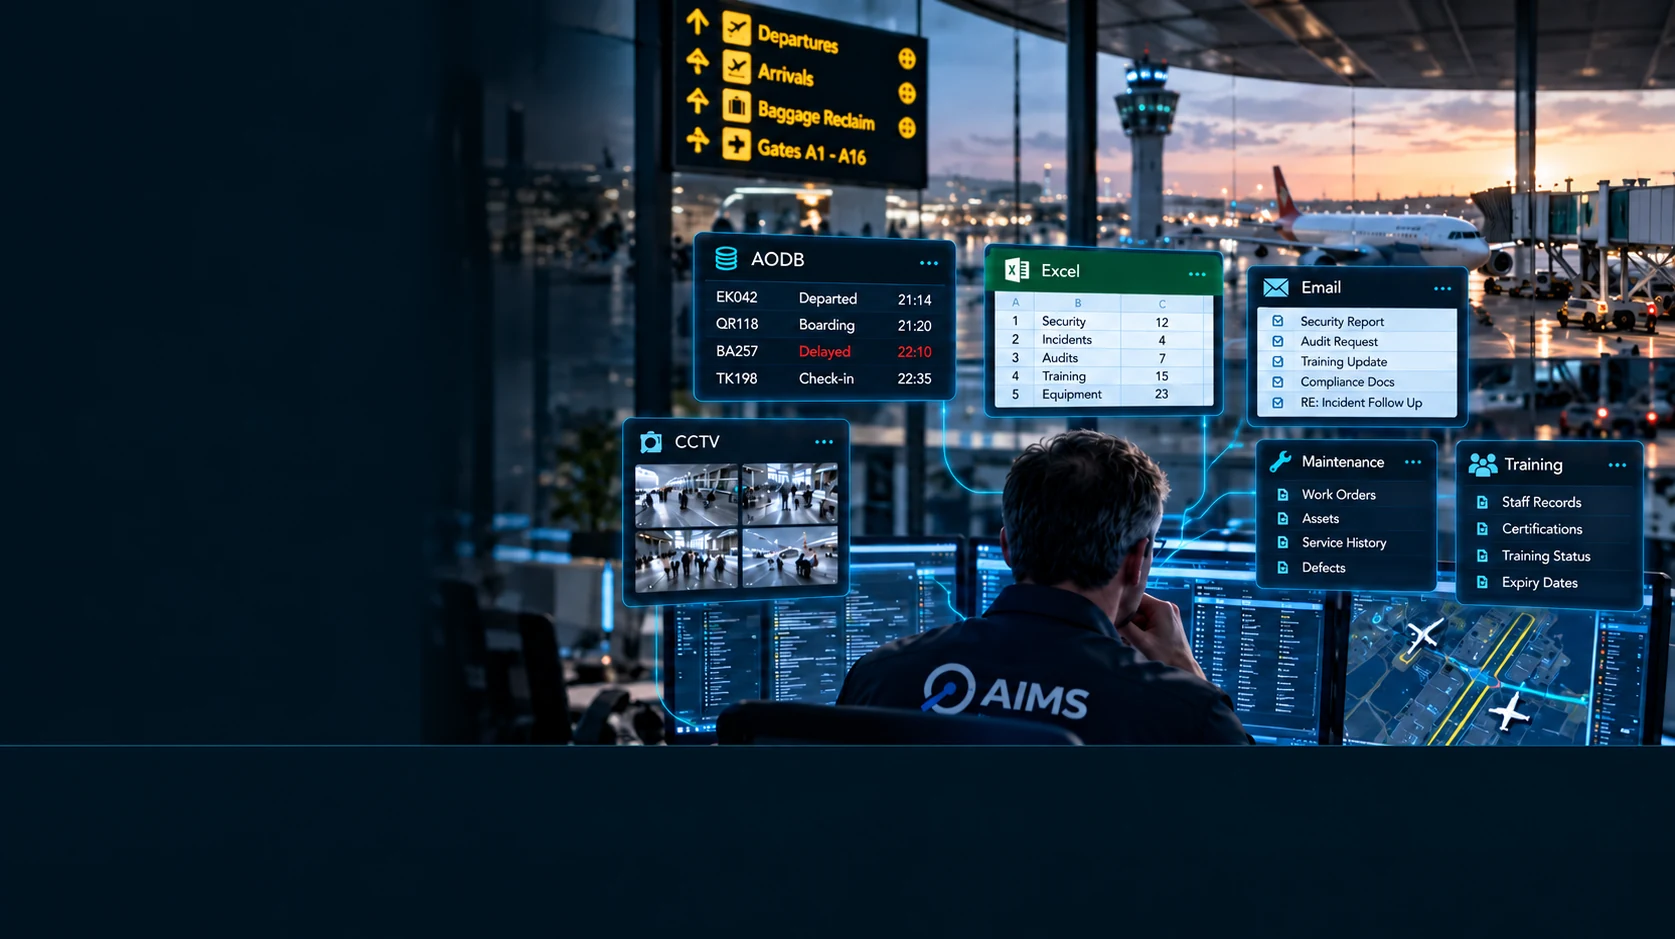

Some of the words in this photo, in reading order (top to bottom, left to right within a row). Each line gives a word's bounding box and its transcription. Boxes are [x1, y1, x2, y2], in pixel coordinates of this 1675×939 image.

[758, 24, 839, 54] Departures
[758, 63, 815, 87] Arrivals
[758, 100, 821, 127] Baggage
[823, 110, 875, 131] Reclaim
[757, 139, 801, 159] Gates
[805, 144, 824, 161] A1
[838, 149, 867, 166] A16
[751, 251, 805, 267] AODB
[1008, 264, 1016, 276] X
[1042, 264, 1080, 278] Excel
[1302, 280, 1341, 294] Email
[716, 291, 758, 304] EK042
[799, 292, 858, 307] Departed
[898, 294, 931, 306] 21:14
[1012, 298, 1020, 307] A
[1075, 299, 1082, 308] B
[1159, 300, 1166, 309] C
[716, 318, 759, 330] QR118
[799, 319, 855, 334] Boarding
[898, 320, 932, 332] 21:20
[1013, 316, 1018, 326] 1
[1042, 316, 1086, 329] Security
[1156, 318, 1169, 328] 12
[1301, 317, 1344, 329] Security
[1347, 317, 1385, 329] Report
[1012, 334, 1019, 344] 2
[1042, 334, 1092, 345] Incidents
[1159, 336, 1166, 345] 4
[1301, 336, 1331, 347] Audit
[1334, 337, 1378, 349] Request
[716, 345, 758, 357] BA257
[799, 346, 851, 360] Delayed
[897, 347, 932, 358] 22:10
[1012, 353, 1019, 363] 3
[1042, 353, 1078, 363] Audits
[1159, 354, 1166, 363] 7
[1301, 356, 1344, 369] Training
[1347, 357, 1388, 369] Update
[716, 373, 758, 385] TK198
[799, 373, 854, 385] Check-in
[898, 373, 932, 385] 22:35
[1012, 371, 1019, 381] 4
[1042, 371, 1086, 384] Training
[1156, 371, 1169, 381] 15
[1301, 377, 1365, 389] Compliance
[1368, 378, 1395, 387] Docs
[1012, 389, 1019, 400] 5
[1042, 389, 1102, 402] Equipment
[1155, 389, 1169, 399] 23
[1301, 398, 1319, 408] RE:
[1322, 398, 1365, 408] Incident
[1368, 398, 1404, 408] Follow
[1407, 398, 1423, 410] Up
[675, 435, 720, 449] CCTV
[1302, 455, 1385, 468] Maintenance
[1505, 457, 1563, 475] Training
[1302, 489, 1333, 500] Work
[1336, 489, 1376, 500] Orders
[1502, 496, 1530, 508] Staff
[1533, 496, 1582, 508] Records
[1302, 513, 1340, 524] Assets
[1502, 522, 1583, 535] Certifications
[1302, 537, 1343, 548] Service
[1346, 537, 1387, 551] History
[1502, 550, 1550, 564] Training
[1553, 550, 1591, 562] Status
[1302, 562, 1346, 573] Defects
[1502, 577, 1540, 591] Expiry
[1543, 577, 1578, 589] Dates
[980, 678, 1090, 720] AIMS
